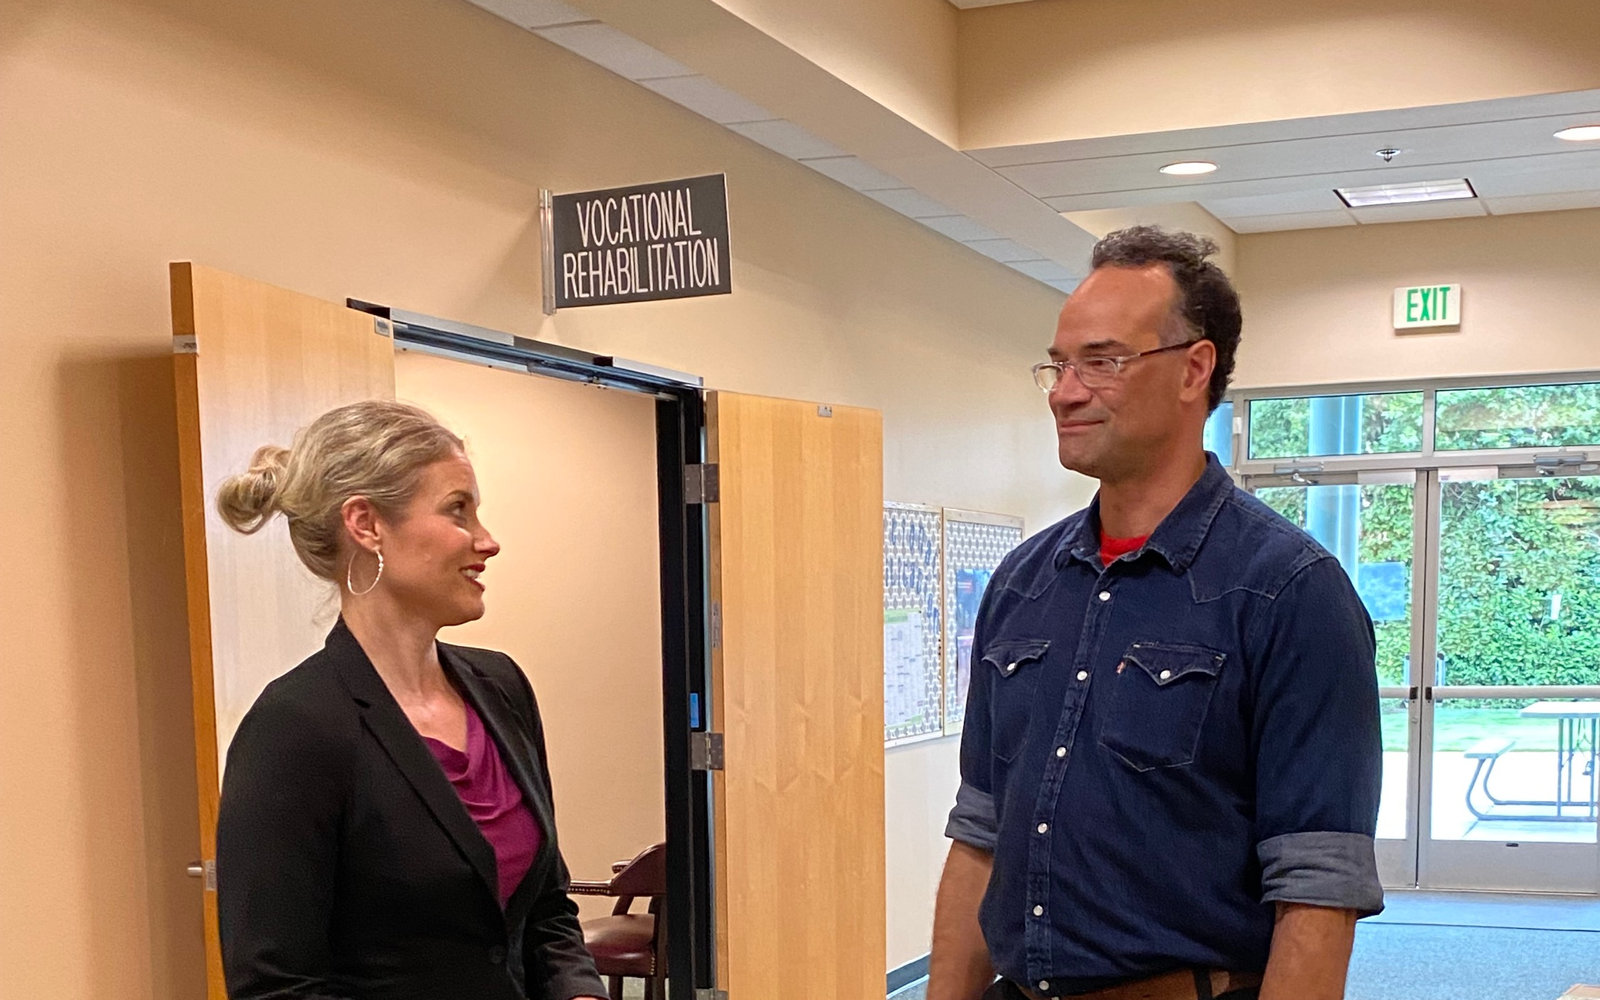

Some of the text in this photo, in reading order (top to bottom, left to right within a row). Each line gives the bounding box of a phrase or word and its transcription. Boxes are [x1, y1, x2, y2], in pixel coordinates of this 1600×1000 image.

[576, 188, 702, 247] VOCATIONAL
[563, 238, 719, 299] REHABILITATION
[1406, 286, 1451, 321] EXIT
